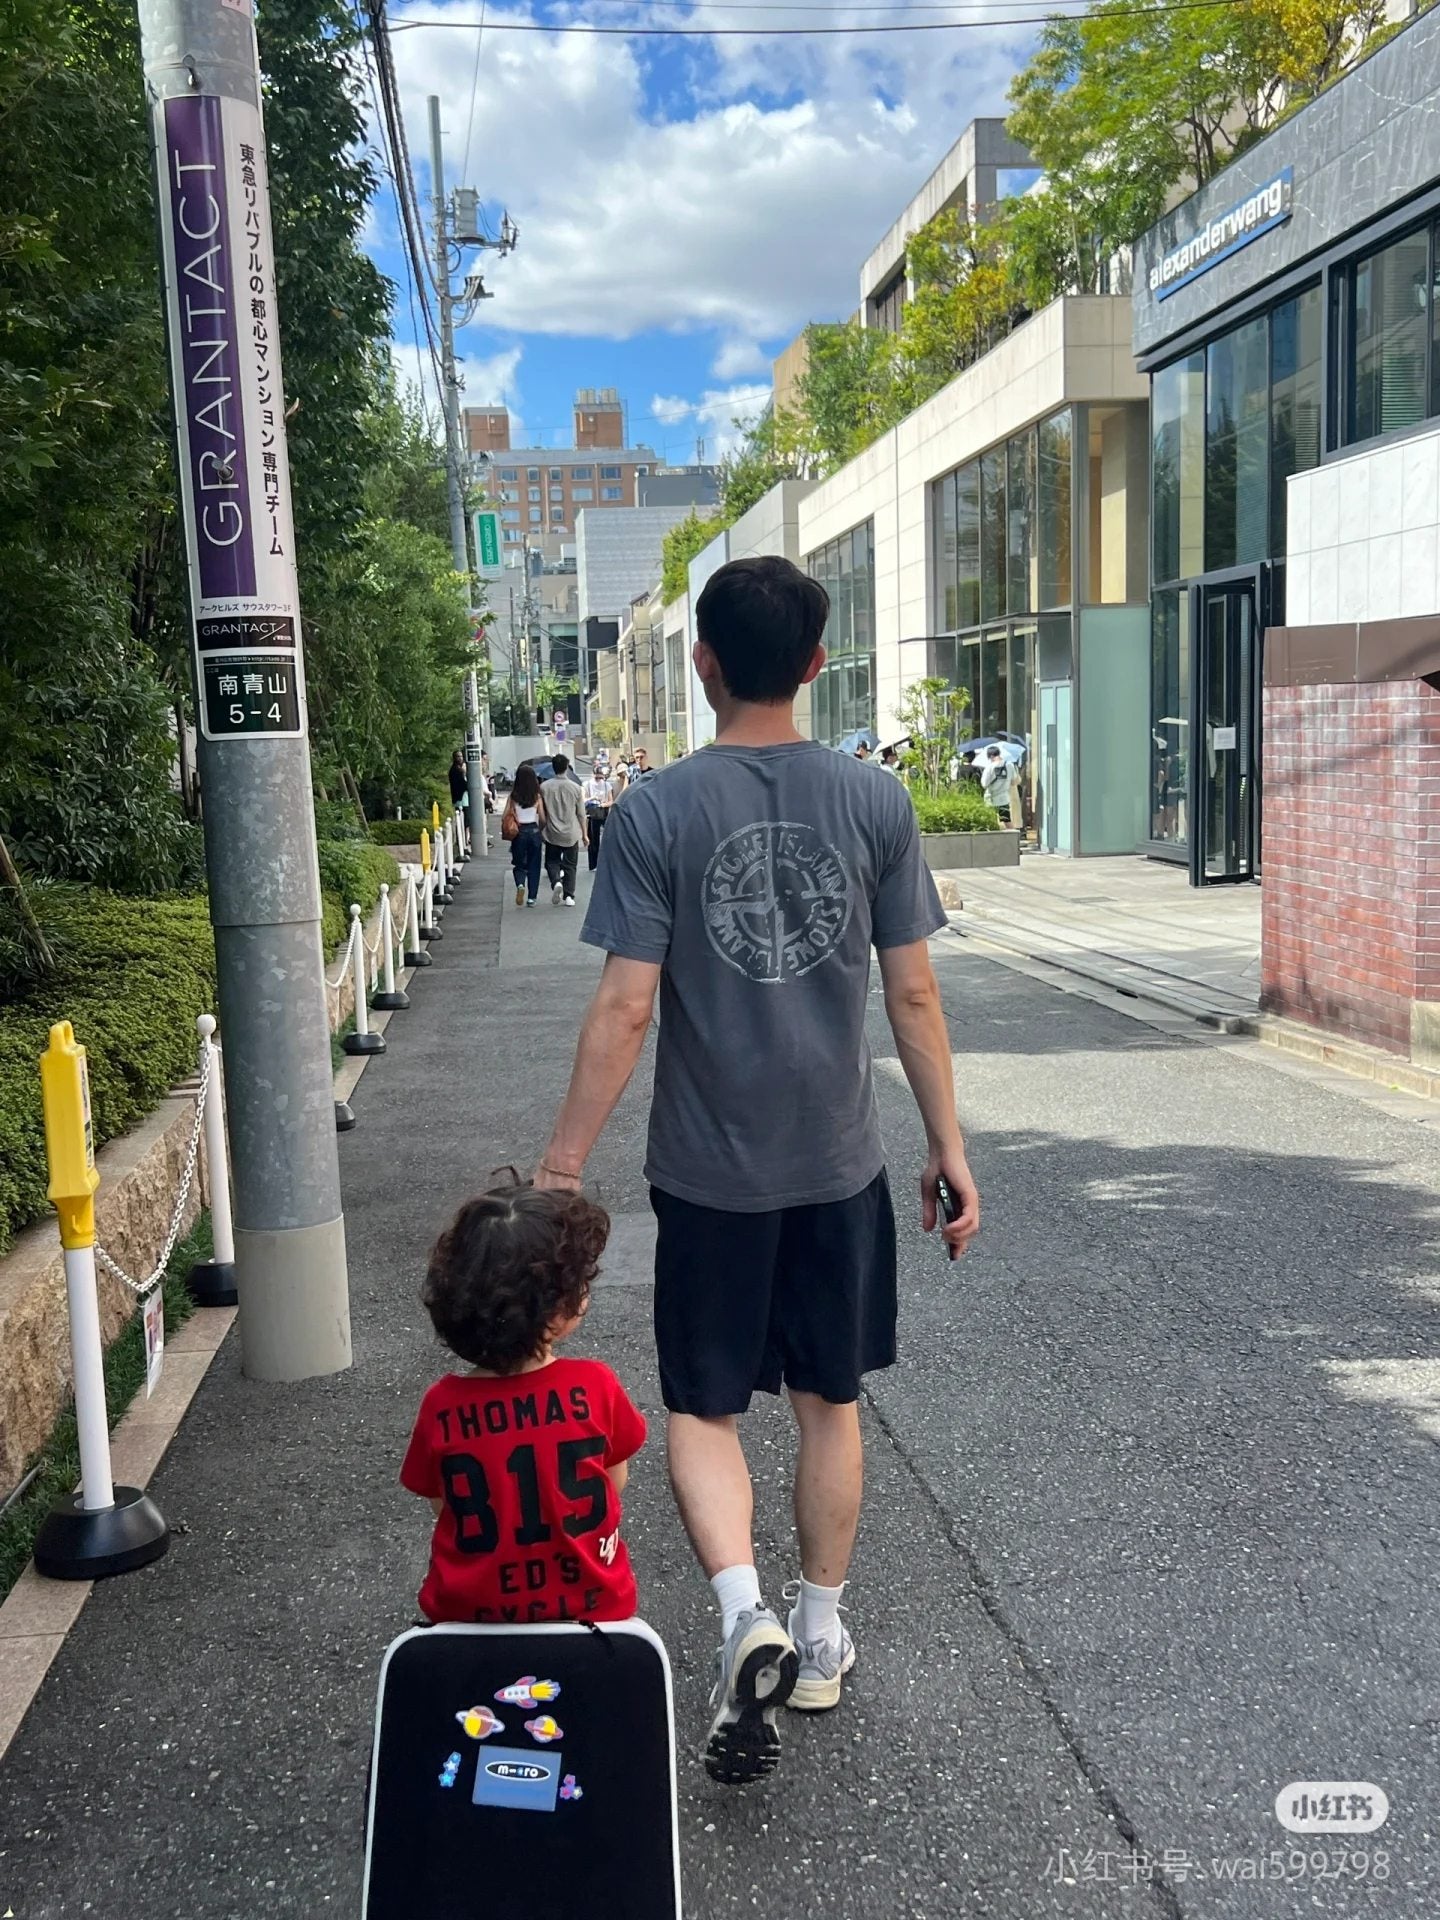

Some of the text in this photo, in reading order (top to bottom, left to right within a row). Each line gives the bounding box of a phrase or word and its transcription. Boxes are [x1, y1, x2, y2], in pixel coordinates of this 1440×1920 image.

[1150, 179, 1282, 290] alexanderwang
[174, 149, 243, 546] GRANTACT
[239, 143, 284, 557] 東急リバブルの都心マンション専門チーム
[199, 604, 240, 613] アークヒルズ
[202, 622, 277, 636] GRANTACT
[217, 672, 287, 696] 南青山
[229, 702, 282, 723] 5-4
[436, 1386, 590, 1443] THOMAS
[440, 1435, 609, 1554] 815
[500, 1552, 582, 1595] ED'S
